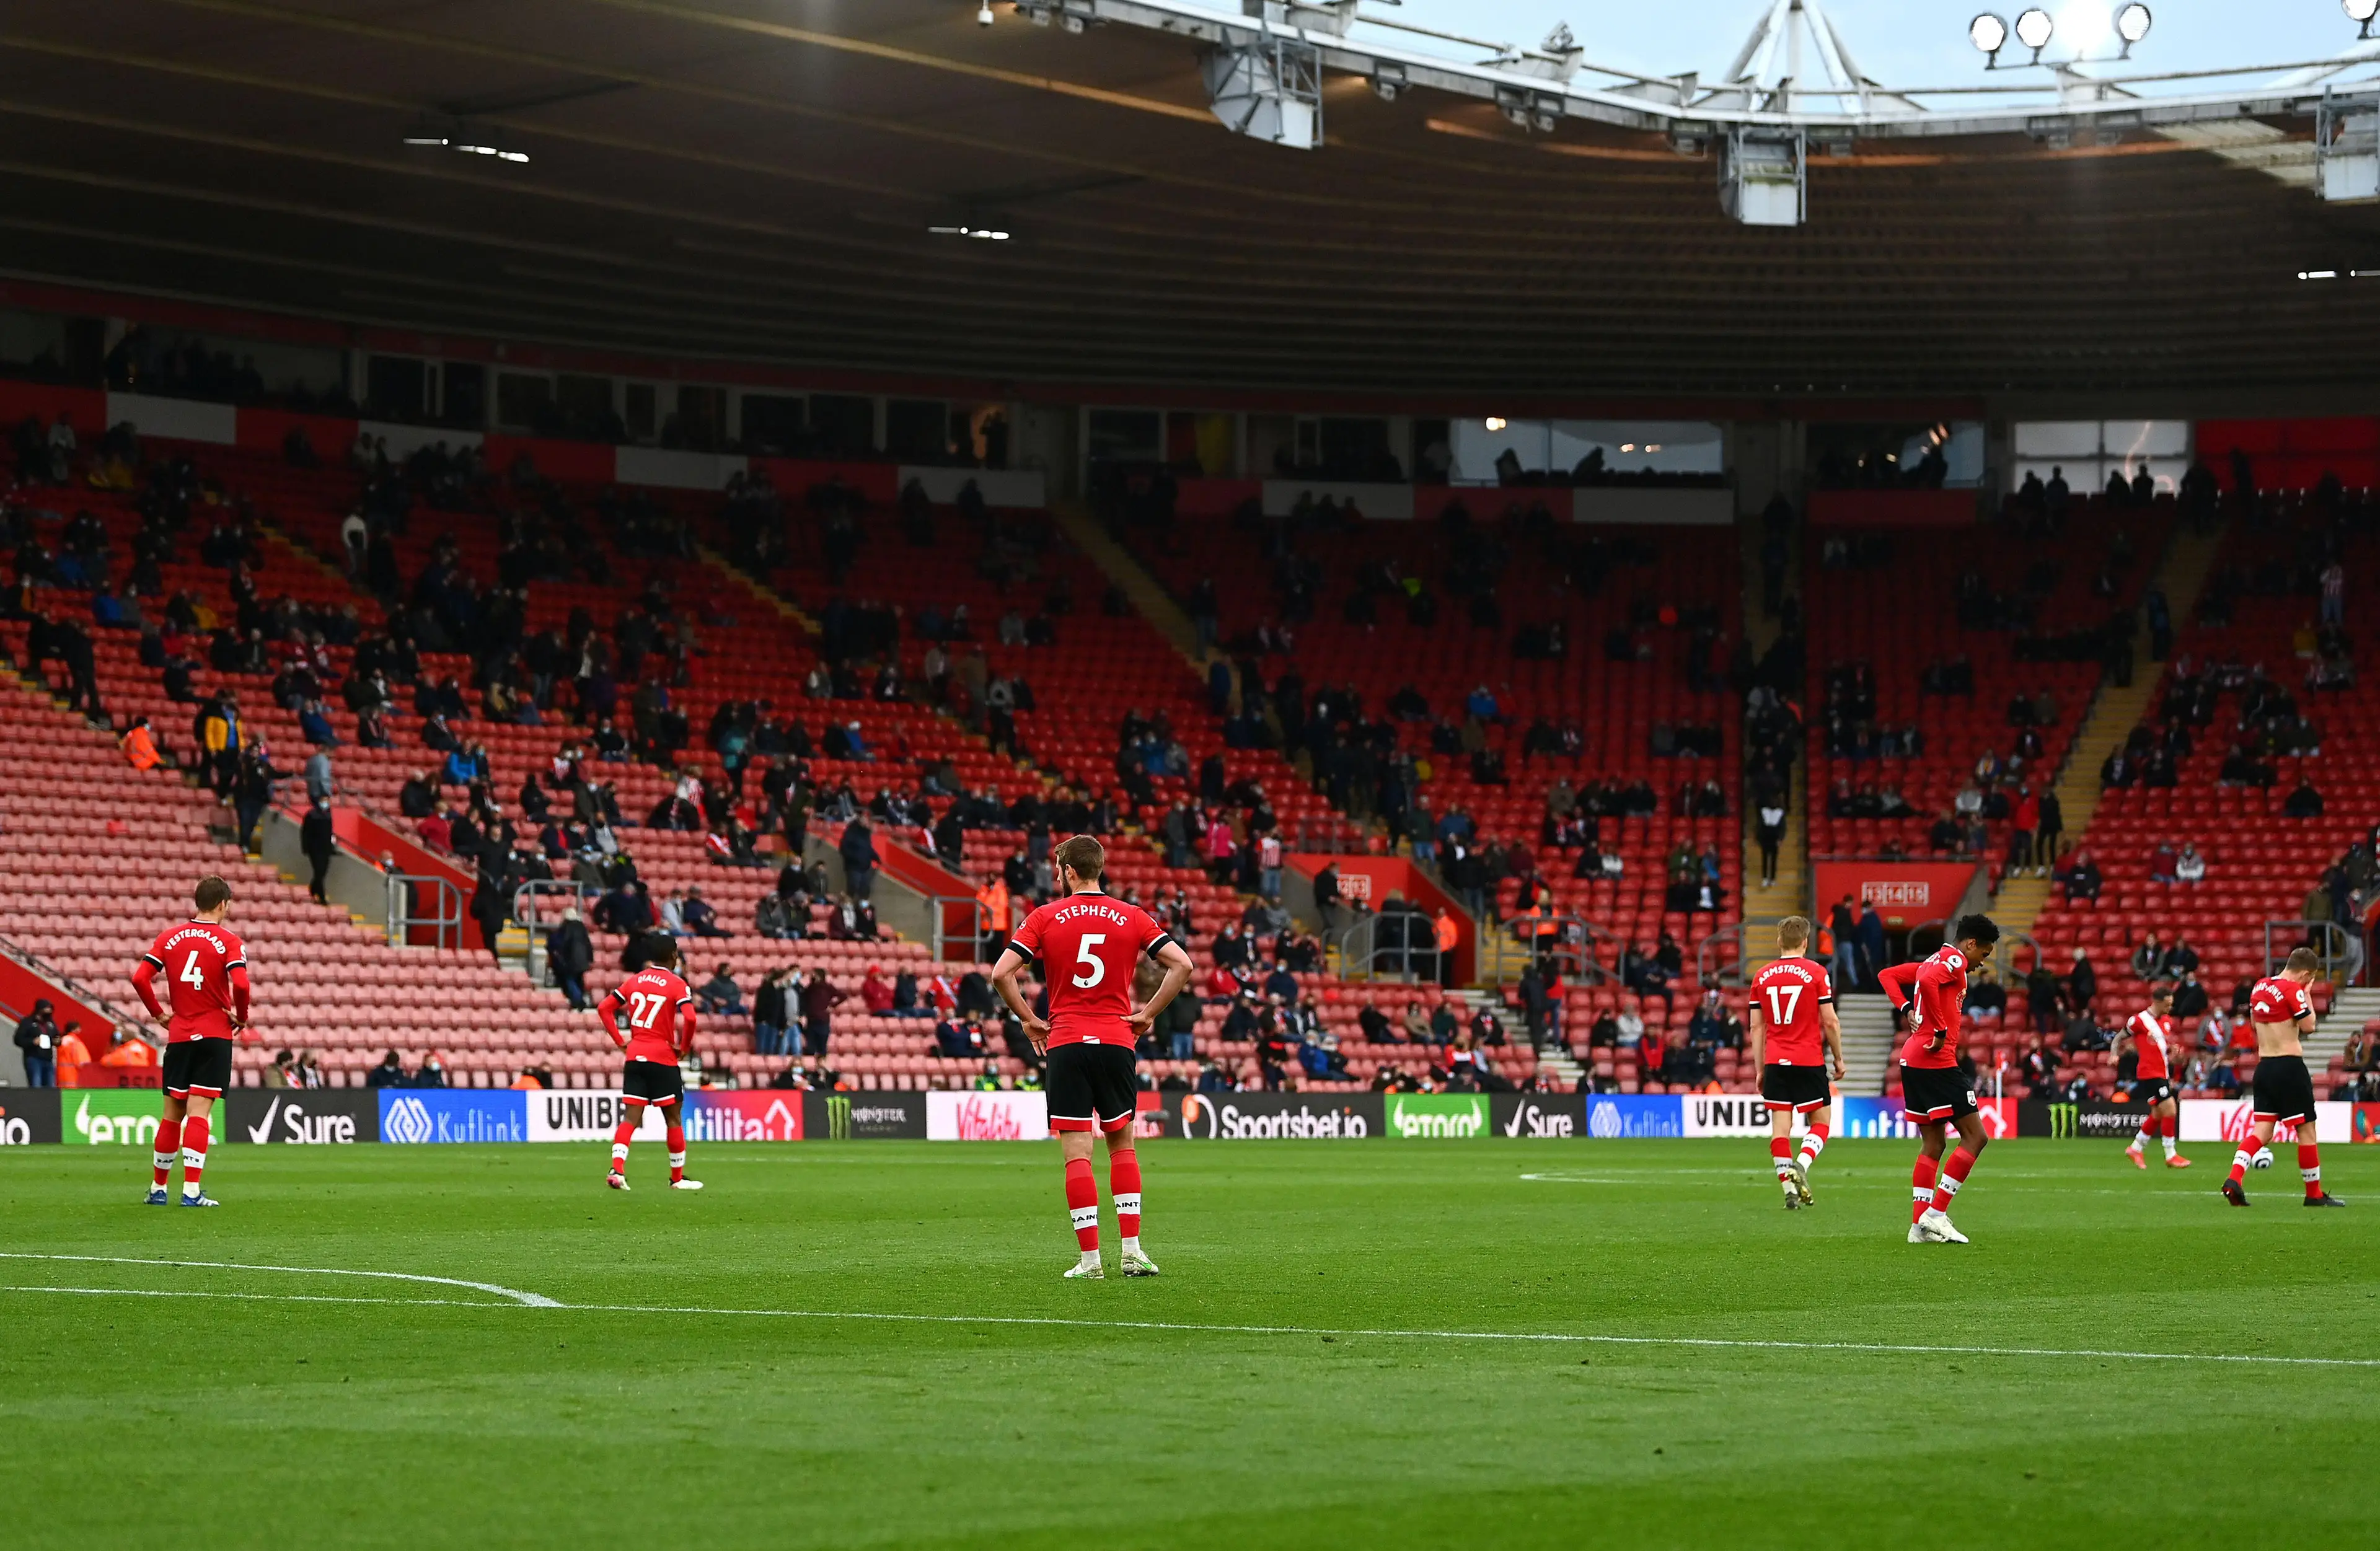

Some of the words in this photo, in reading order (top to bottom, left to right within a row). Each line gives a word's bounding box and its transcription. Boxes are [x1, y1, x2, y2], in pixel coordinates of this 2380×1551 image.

[1055, 905, 1127, 926] STEPHENS
[164, 929, 226, 954] VESTERGAARD
[180, 951, 204, 990] 4
[1072, 933, 1106, 988] 5
[1758, 964, 1813, 985] ARMSTRONG
[638, 975, 667, 986] DIALLO
[630, 991, 667, 1029] 27
[1766, 985, 1804, 1024] 17
[283, 1104, 356, 1144] Sure
[438, 1108, 521, 1142] Kuflink
[851, 1105, 907, 1123] MONSTER
[956, 1093, 1021, 1140] Vitality
[1221, 1104, 1367, 1140] Sportsbet.io
[1526, 1105, 1573, 1138] Sure
[1623, 1109, 1680, 1138] Kuflink
